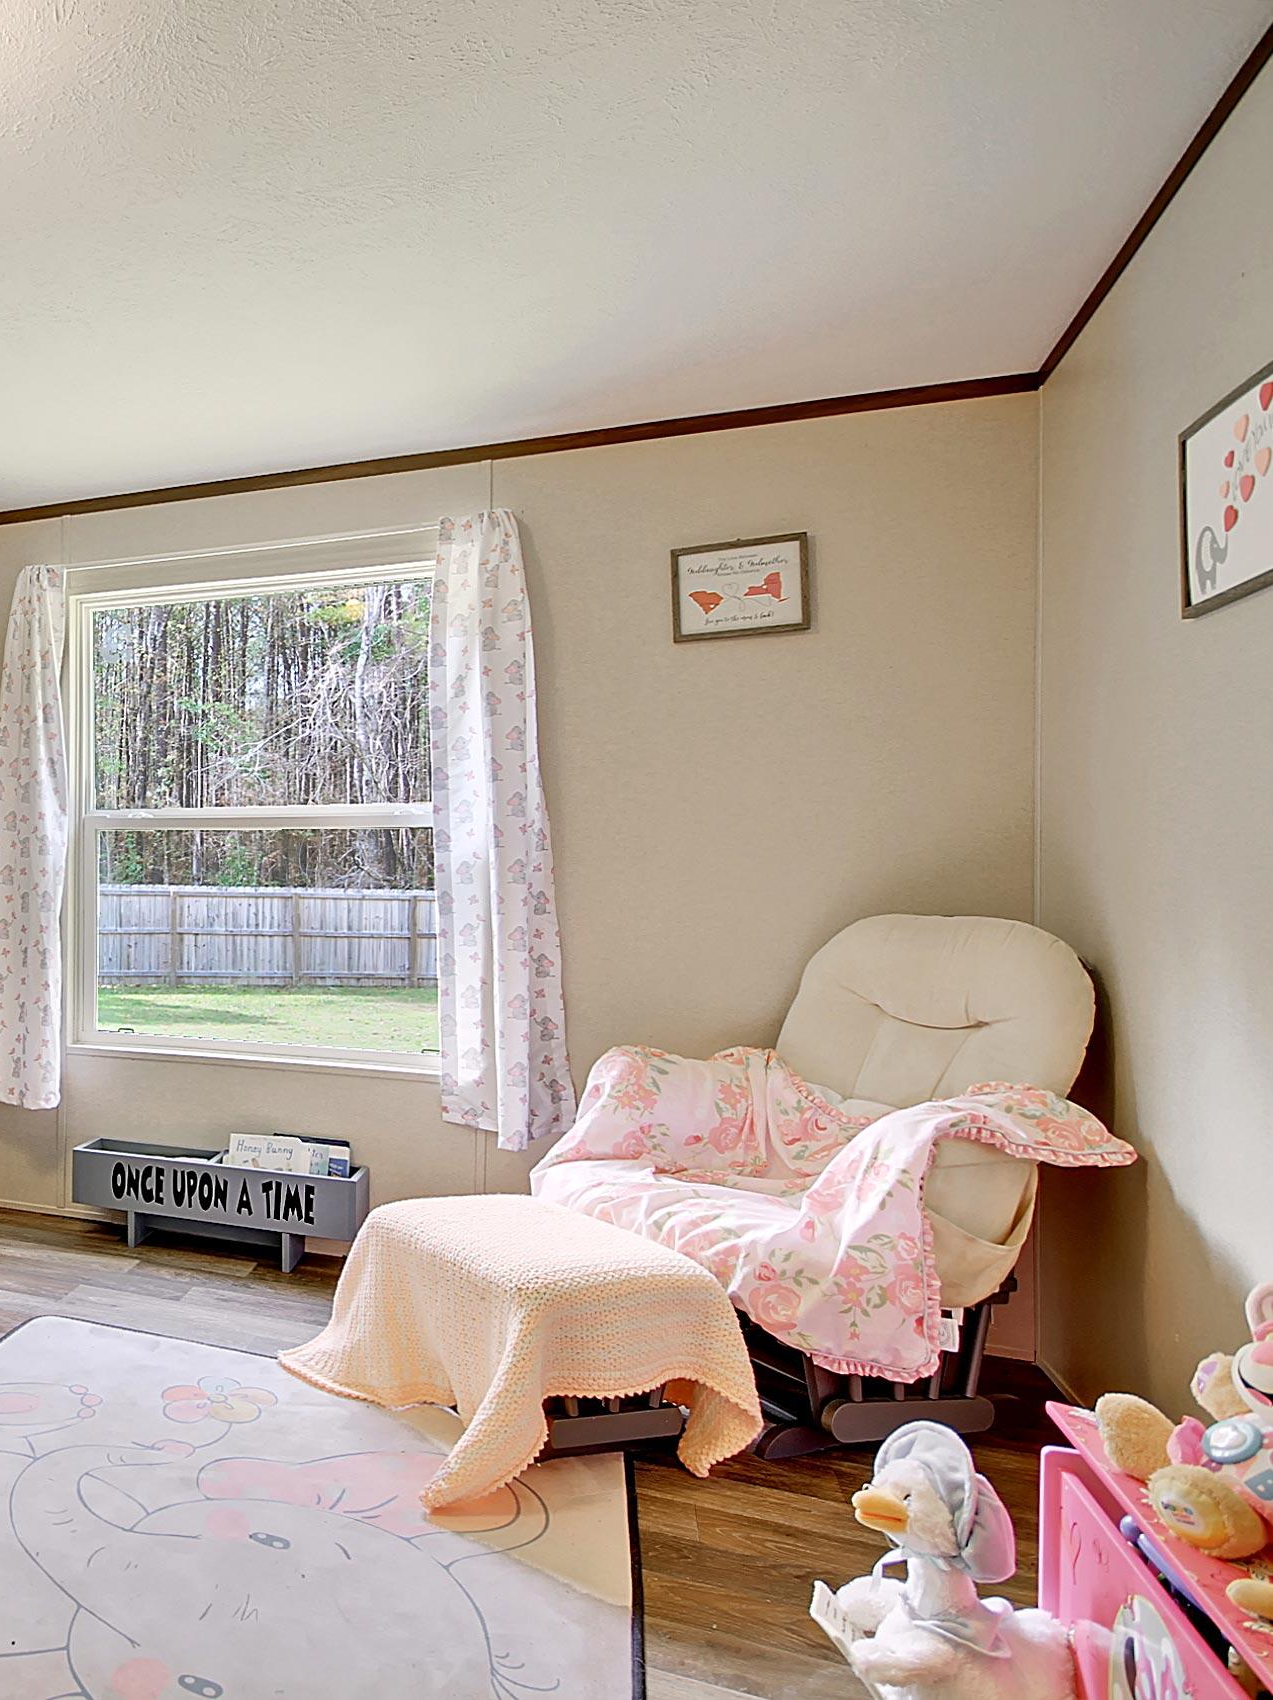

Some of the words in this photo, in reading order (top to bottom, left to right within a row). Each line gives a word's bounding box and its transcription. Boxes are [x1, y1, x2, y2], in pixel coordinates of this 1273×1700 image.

[236, 1139, 262, 1158] Honey
[266, 1141, 294, 1161] Bunny
[111, 1161, 165, 1206] ONCE
[172, 1168, 229, 1213] UPON
[236, 1178, 254, 1217] A
[261, 1180, 316, 1226] TIME
